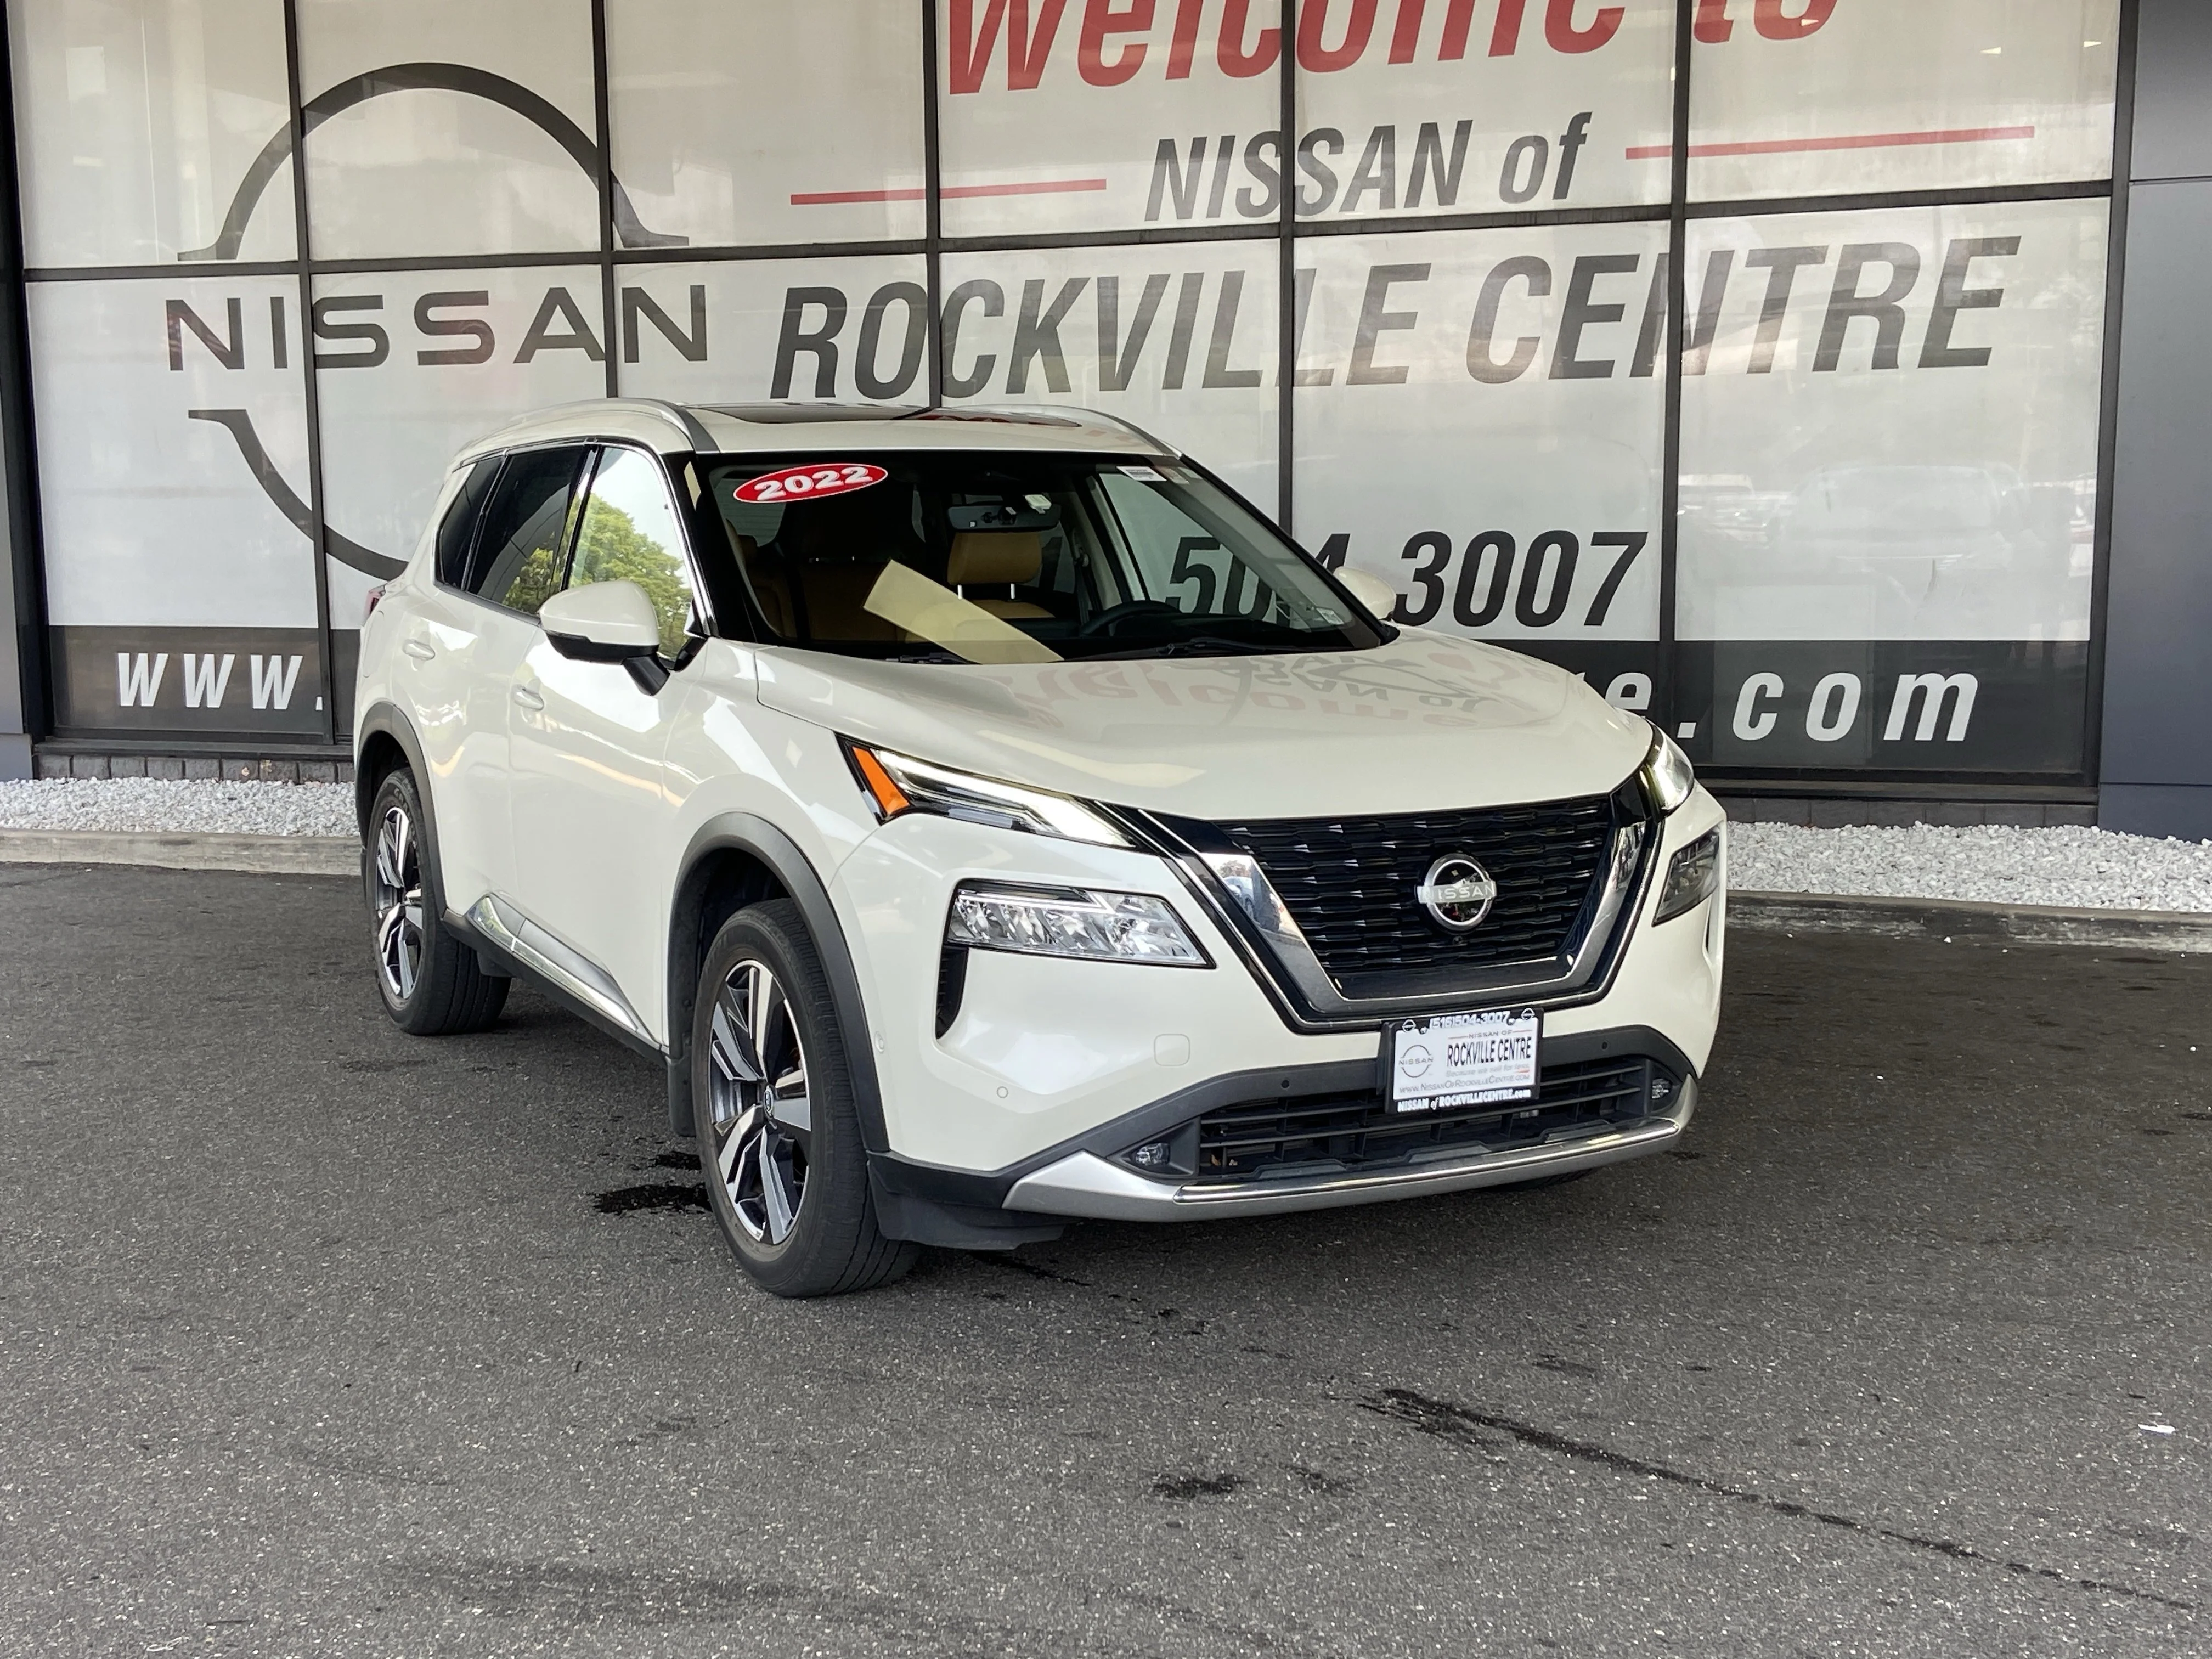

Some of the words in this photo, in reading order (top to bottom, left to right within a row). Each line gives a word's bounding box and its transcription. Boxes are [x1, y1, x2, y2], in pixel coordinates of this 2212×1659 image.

[1144, 120, 1473, 222] NISSAN
[1498, 111, 1593, 205] of
[166, 285, 708, 371] NISSAN
[770, 263, 1432, 399] ROCKVILLE
[1466, 235, 2022, 384] CENTRE
[754, 466, 873, 501] 2022
[1574, 672, 1978, 742] e.com
[1422, 884, 1494, 901] NISSAN
[1398, 1057, 1434, 1065] NISSAN
[1447, 1040, 1496, 1066] ROCKVILLE
[1498, 1036, 1532, 1063] CENTRE
[1397, 1098, 1429, 1113] NISSAN
[1430, 1097, 1439, 1110] of
